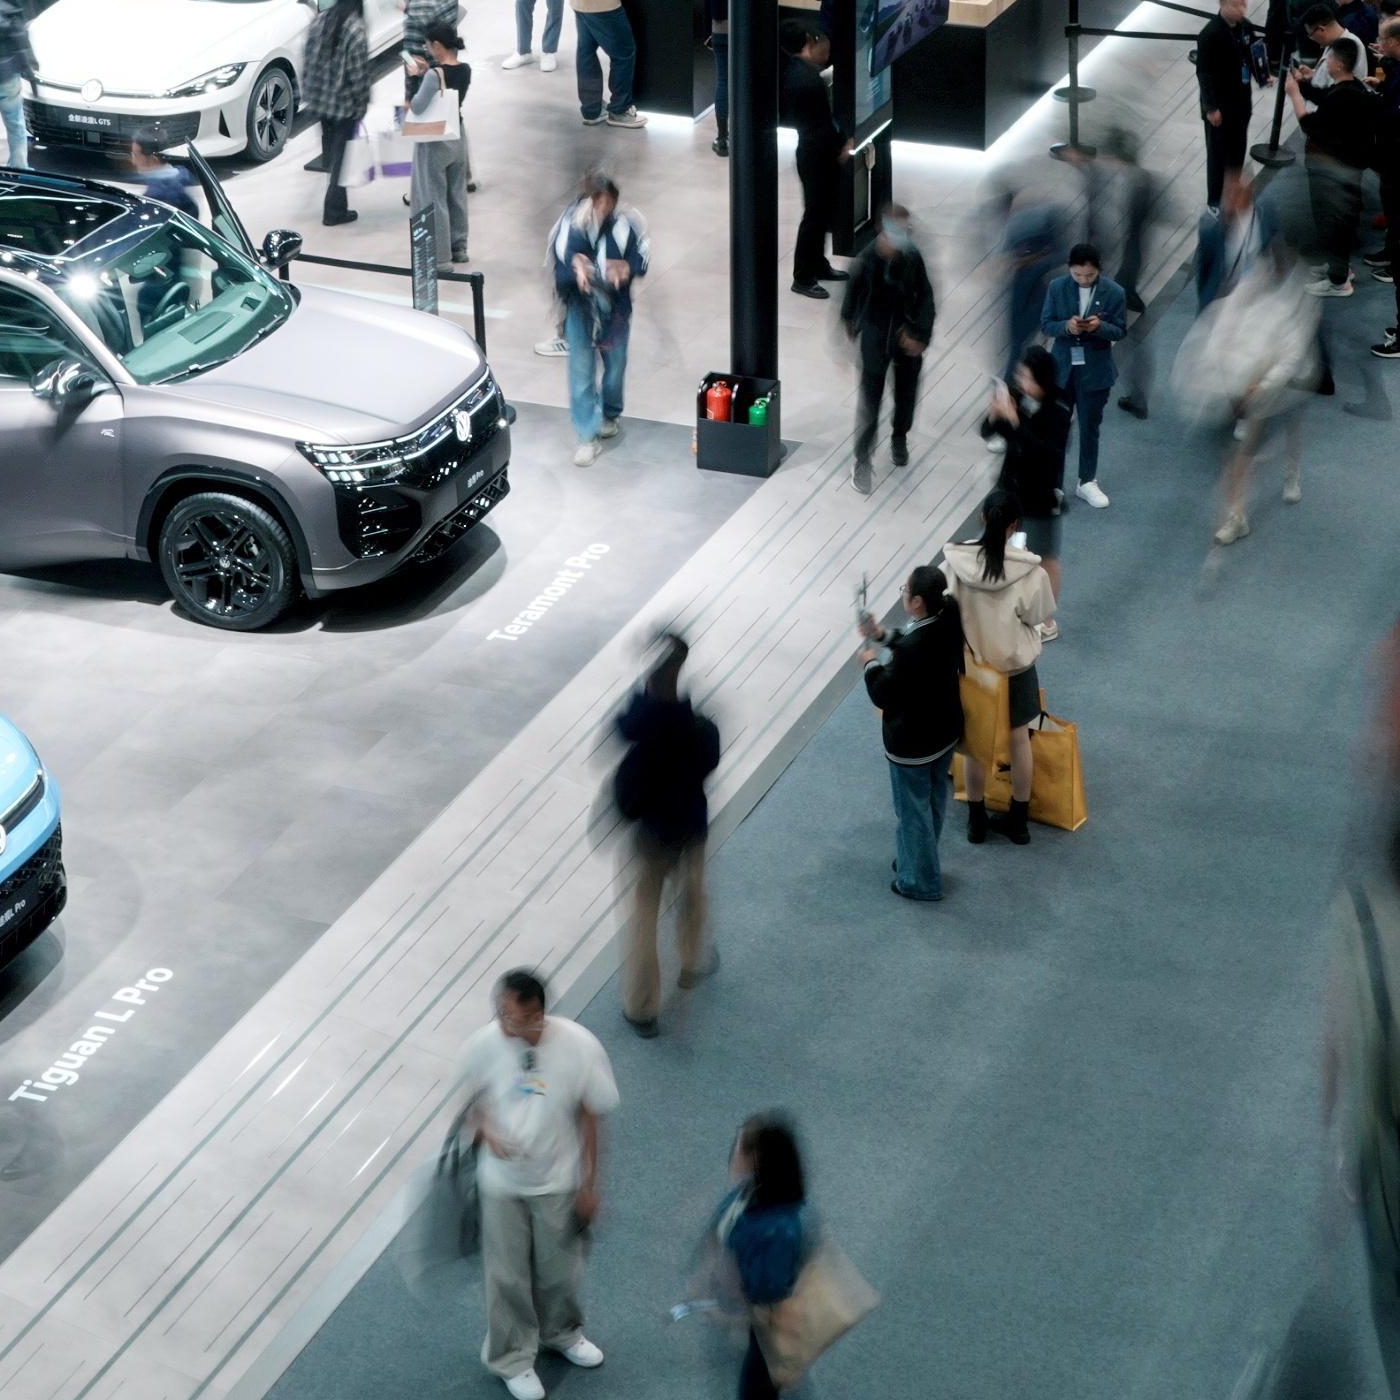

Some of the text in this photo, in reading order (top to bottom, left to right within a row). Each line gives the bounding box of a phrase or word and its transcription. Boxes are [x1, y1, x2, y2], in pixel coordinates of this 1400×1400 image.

[486, 541, 611, 642] Teramont Pro
[14, 899, 26, 913] Pro
[8, 967, 175, 1103] Tiguan L Pro
